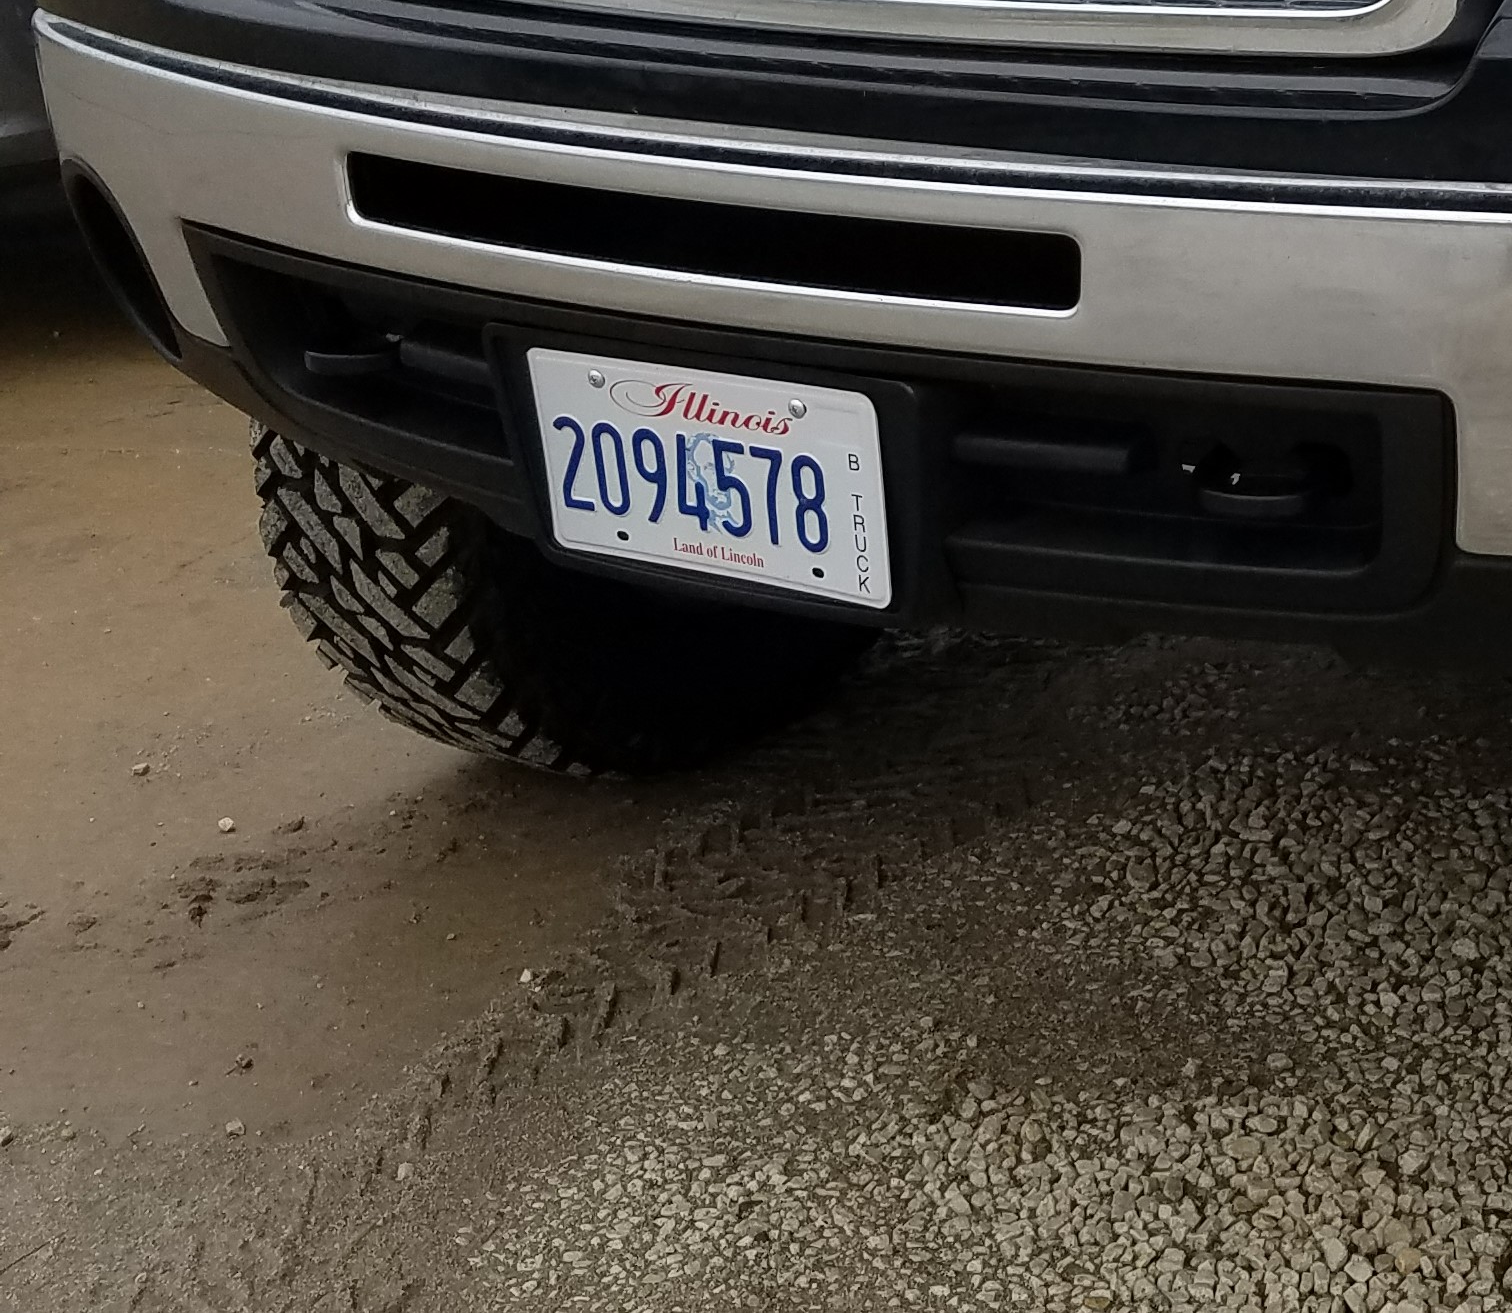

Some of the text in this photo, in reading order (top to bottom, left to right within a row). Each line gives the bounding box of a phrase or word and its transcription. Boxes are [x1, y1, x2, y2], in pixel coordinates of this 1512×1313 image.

[609, 379, 793, 436] Illinois
[552, 415, 829, 553] 2094578
[847, 452, 872, 594] B TRUCK
[672, 537, 765, 569] Land of Lincoln
